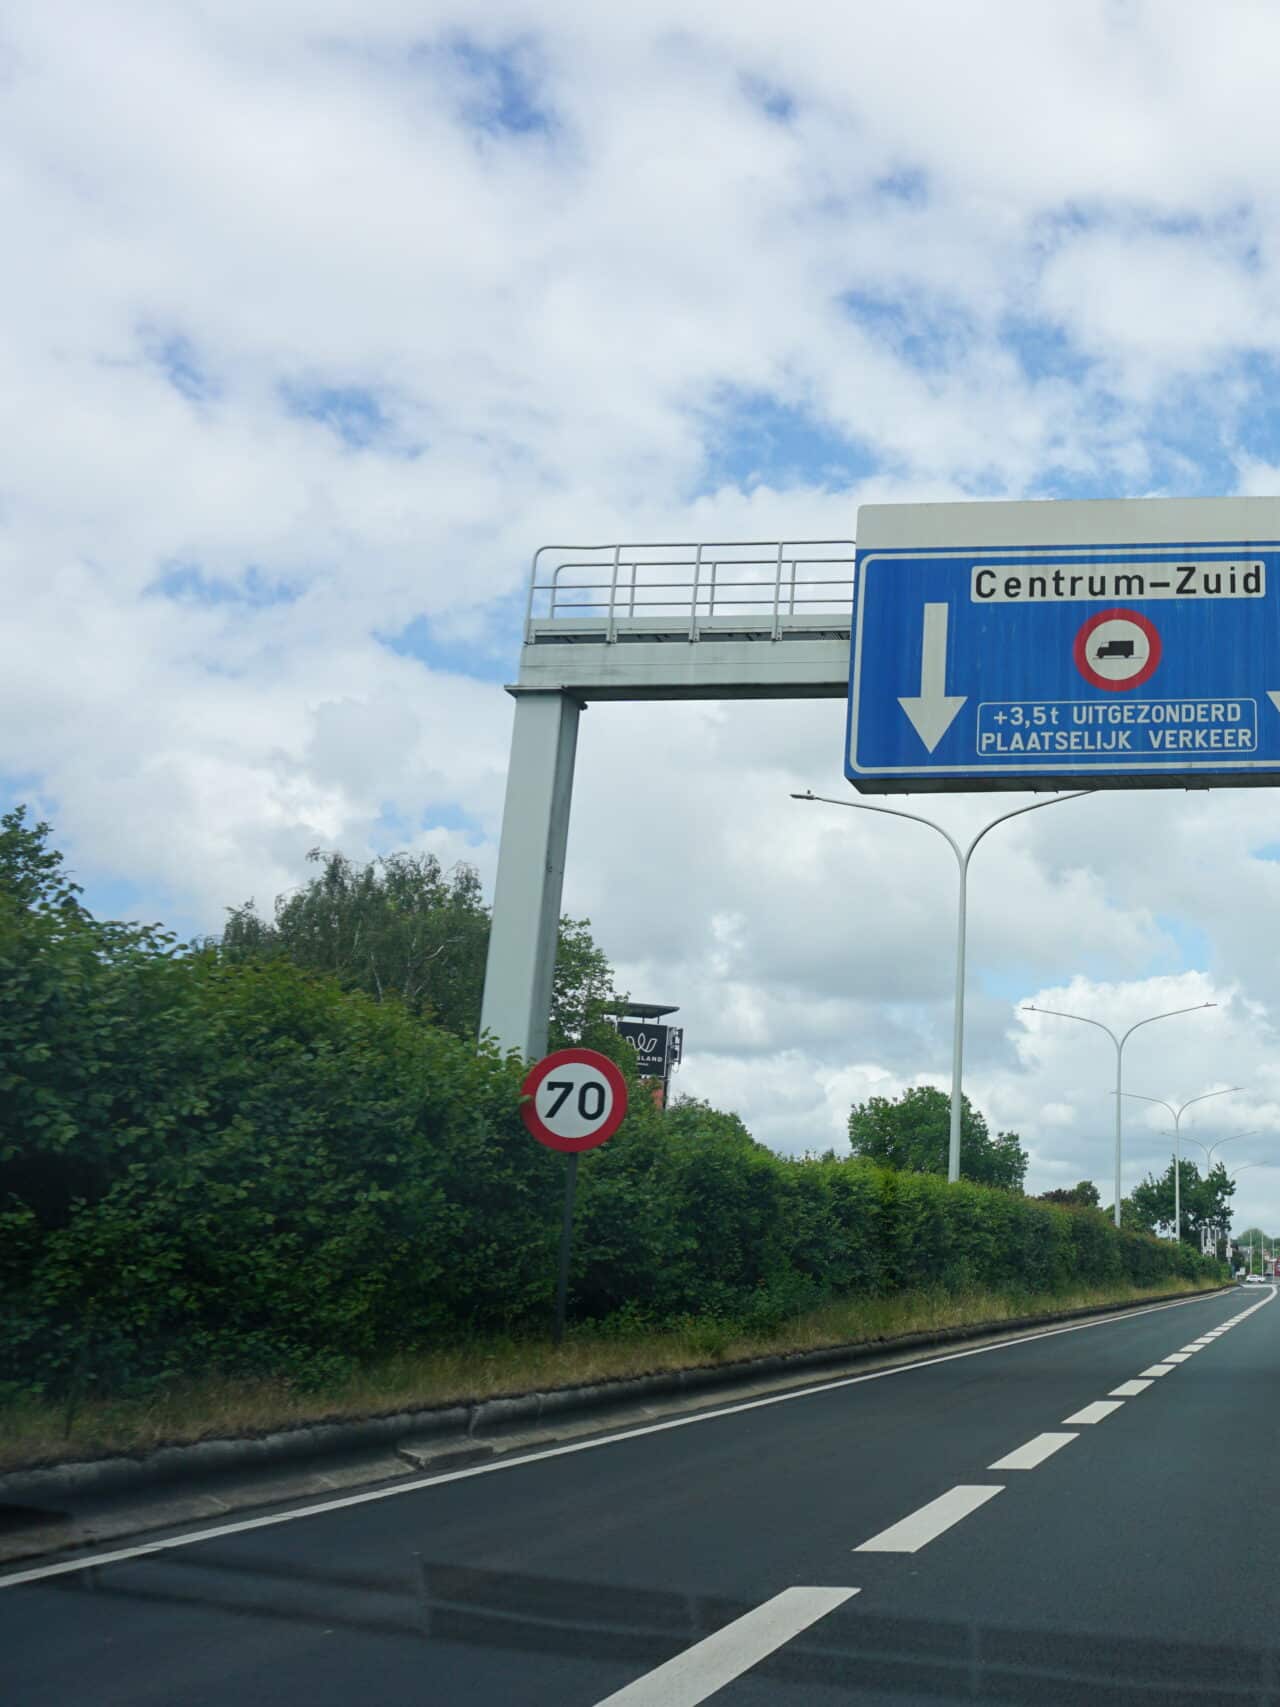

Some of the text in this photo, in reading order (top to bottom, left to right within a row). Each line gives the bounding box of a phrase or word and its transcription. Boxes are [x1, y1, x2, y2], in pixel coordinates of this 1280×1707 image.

[975, 565, 1262, 599] Centrum-Zuid
[1072, 703, 1242, 725] UITGEZONDERD
[981, 728, 1253, 752] PLAATSELIJK VERKEER
[545, 1081, 606, 1121] 70
